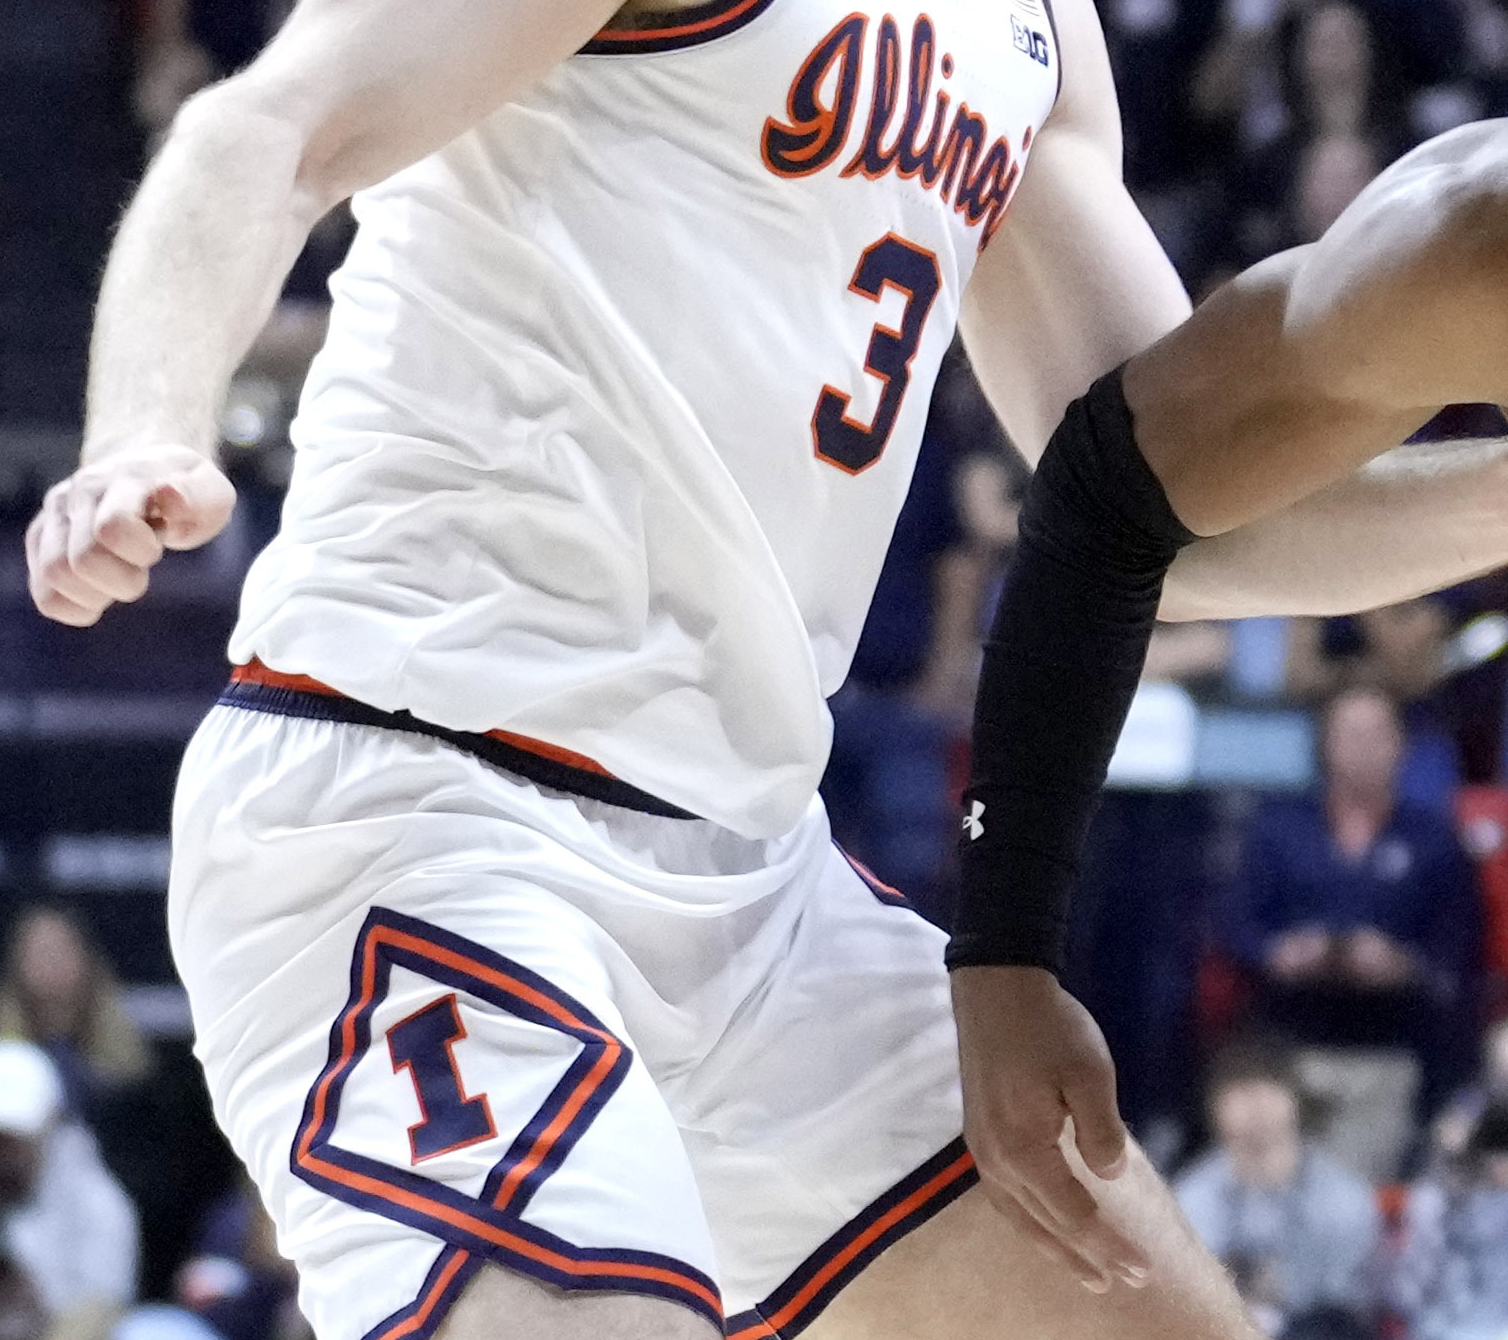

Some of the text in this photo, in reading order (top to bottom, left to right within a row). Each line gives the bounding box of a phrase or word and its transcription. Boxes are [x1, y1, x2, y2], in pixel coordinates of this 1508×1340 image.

[760, 10, 1033, 253] Illinoi
[810, 231, 942, 477] 3
[385, 993, 499, 1166] I
